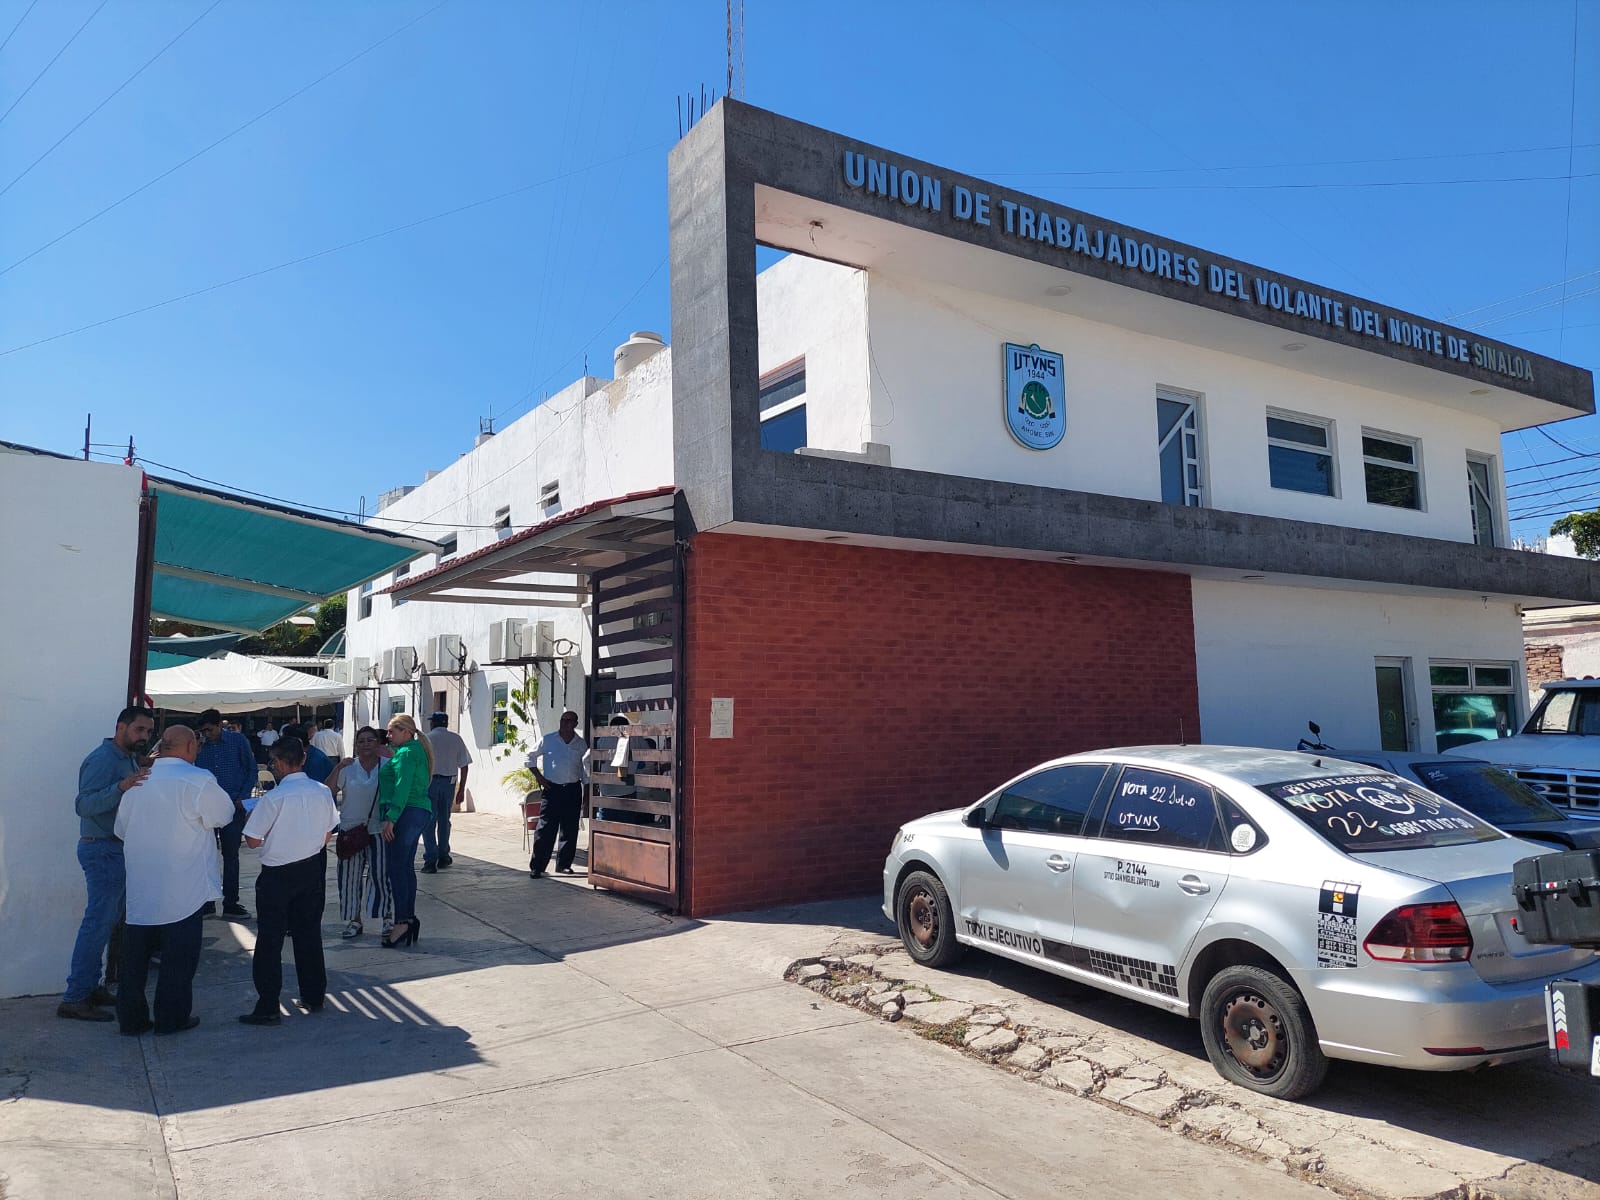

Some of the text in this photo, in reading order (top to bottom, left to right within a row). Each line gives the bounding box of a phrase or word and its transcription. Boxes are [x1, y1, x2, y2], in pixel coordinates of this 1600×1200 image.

[843, 150, 1536, 382] UNION DE TRABAJADORES DEL VOLANTE DEL NORTE DE SINALOA
[1013, 351, 1057, 378] UTVNS
[1027, 369, 1045, 380] 1944
[1121, 781, 1148, 797] VOTA
[1149, 786, 1167, 803] 22
[1288, 789, 1361, 812] VOTA
[1327, 811, 1378, 837] 22
[1117, 860, 1147, 876] P. 2144
[1318, 912, 1358, 925] TAXI
[965, 919, 1041, 954] TAXI EJECUTIVO
